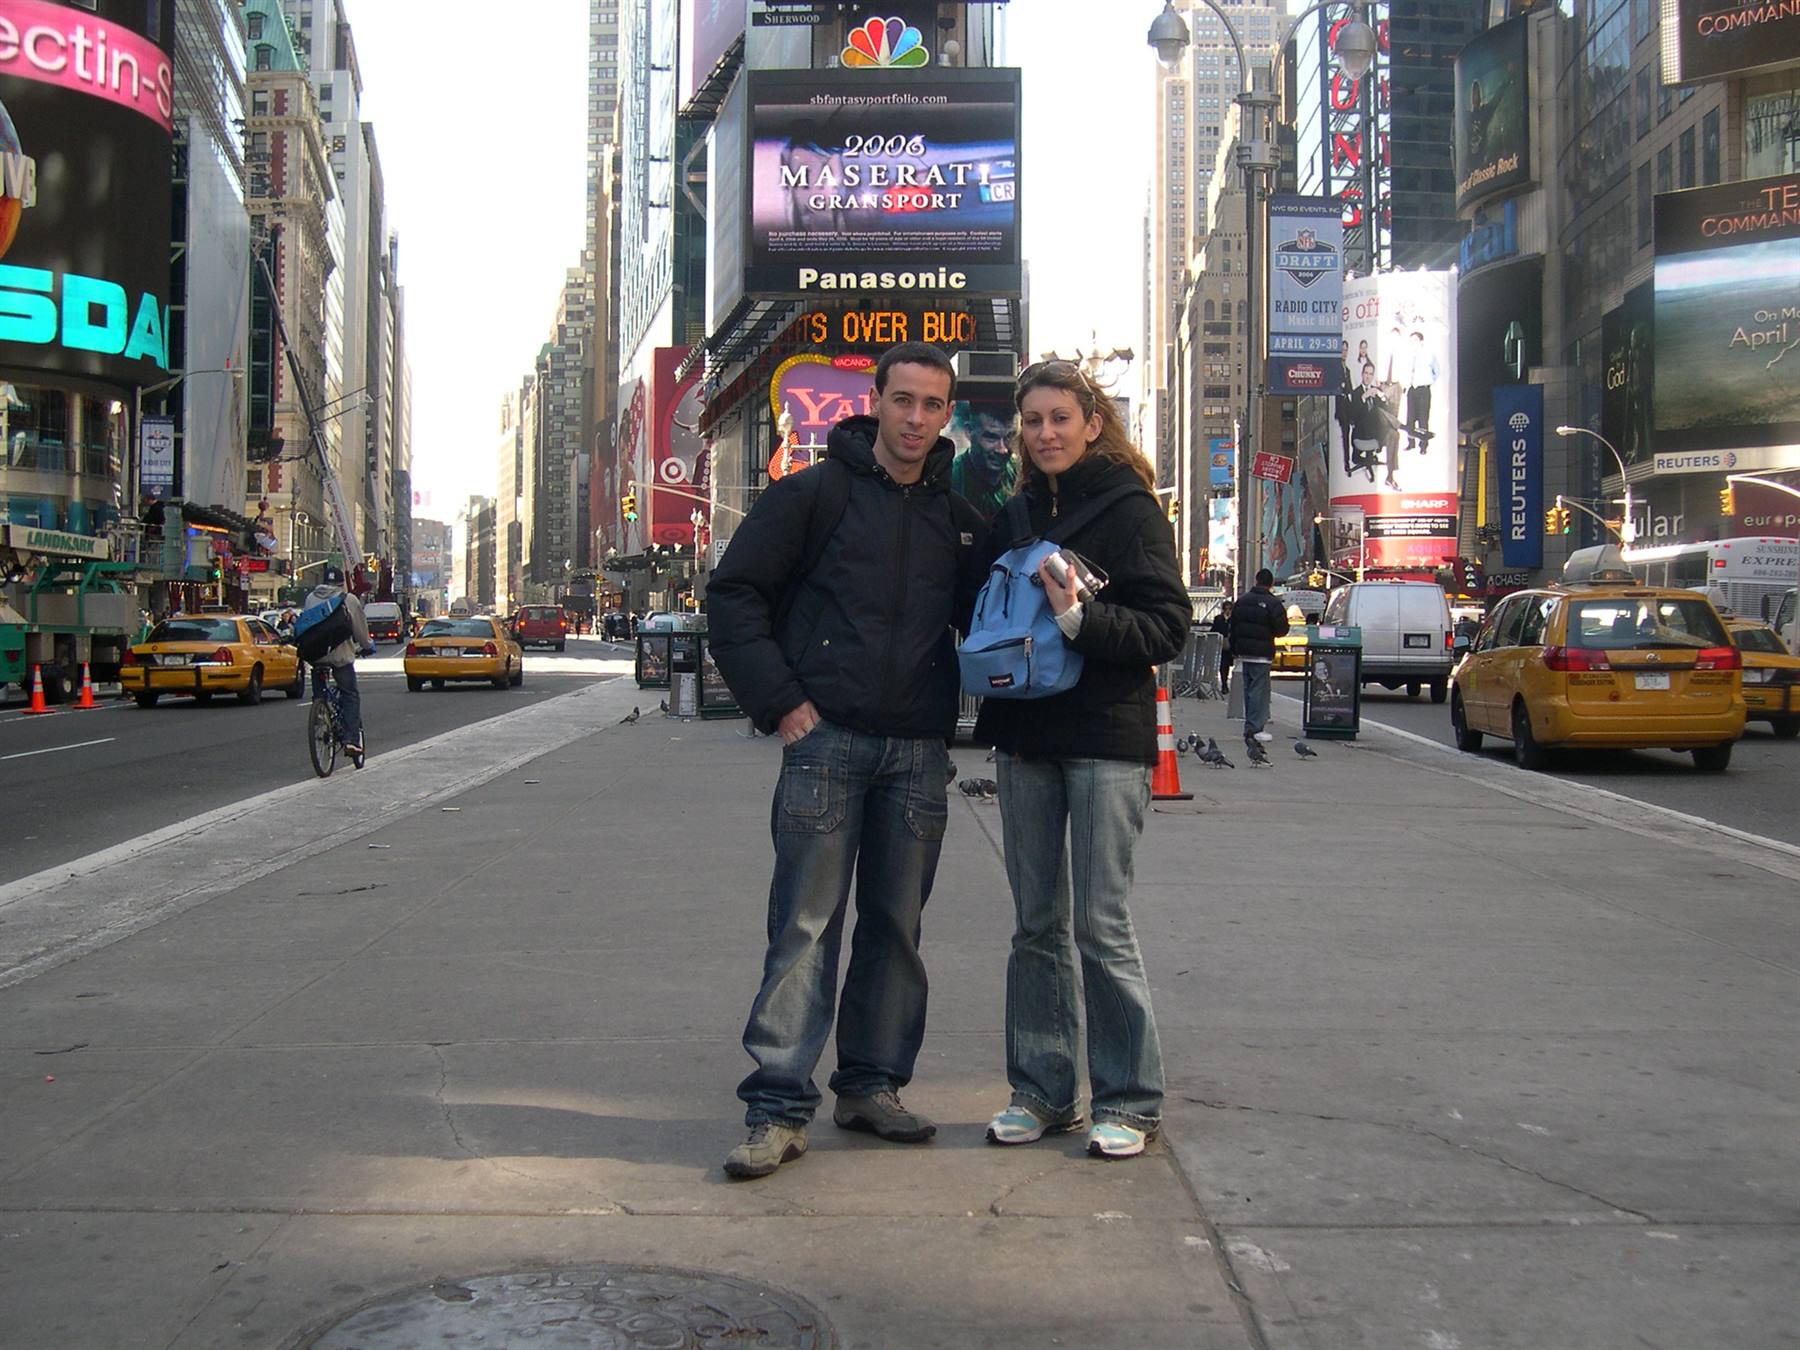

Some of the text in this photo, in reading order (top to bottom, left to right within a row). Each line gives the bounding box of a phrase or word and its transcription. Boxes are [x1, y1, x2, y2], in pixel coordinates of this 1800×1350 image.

[810, 93, 948, 106] sbfantasyportfolio.com
[842, 134, 927, 158] 2006
[1497, 153, 1519, 176] Rock
[779, 163, 991, 188] MASERATI
[808, 193, 962, 210] GRANSPORT
[1280, 255, 1334, 267] DRAFT
[798, 268, 967, 289] Panasonic
[1275, 300, 1338, 313] RADIO CITY
[1754, 310, 1777, 322] On
[843, 312, 907, 343] OVER
[1274, 338, 1338, 350] APRIL 29-30
[1729, 323, 1786, 350] April
[835, 359, 872, 367] VACANCY
[1656, 455, 1720, 469] REUTERS
[1511, 438, 1527, 540] REUTERS
[26, 530, 96, 554] LANDMARK
[1495, 574, 1529, 586] CHASE
